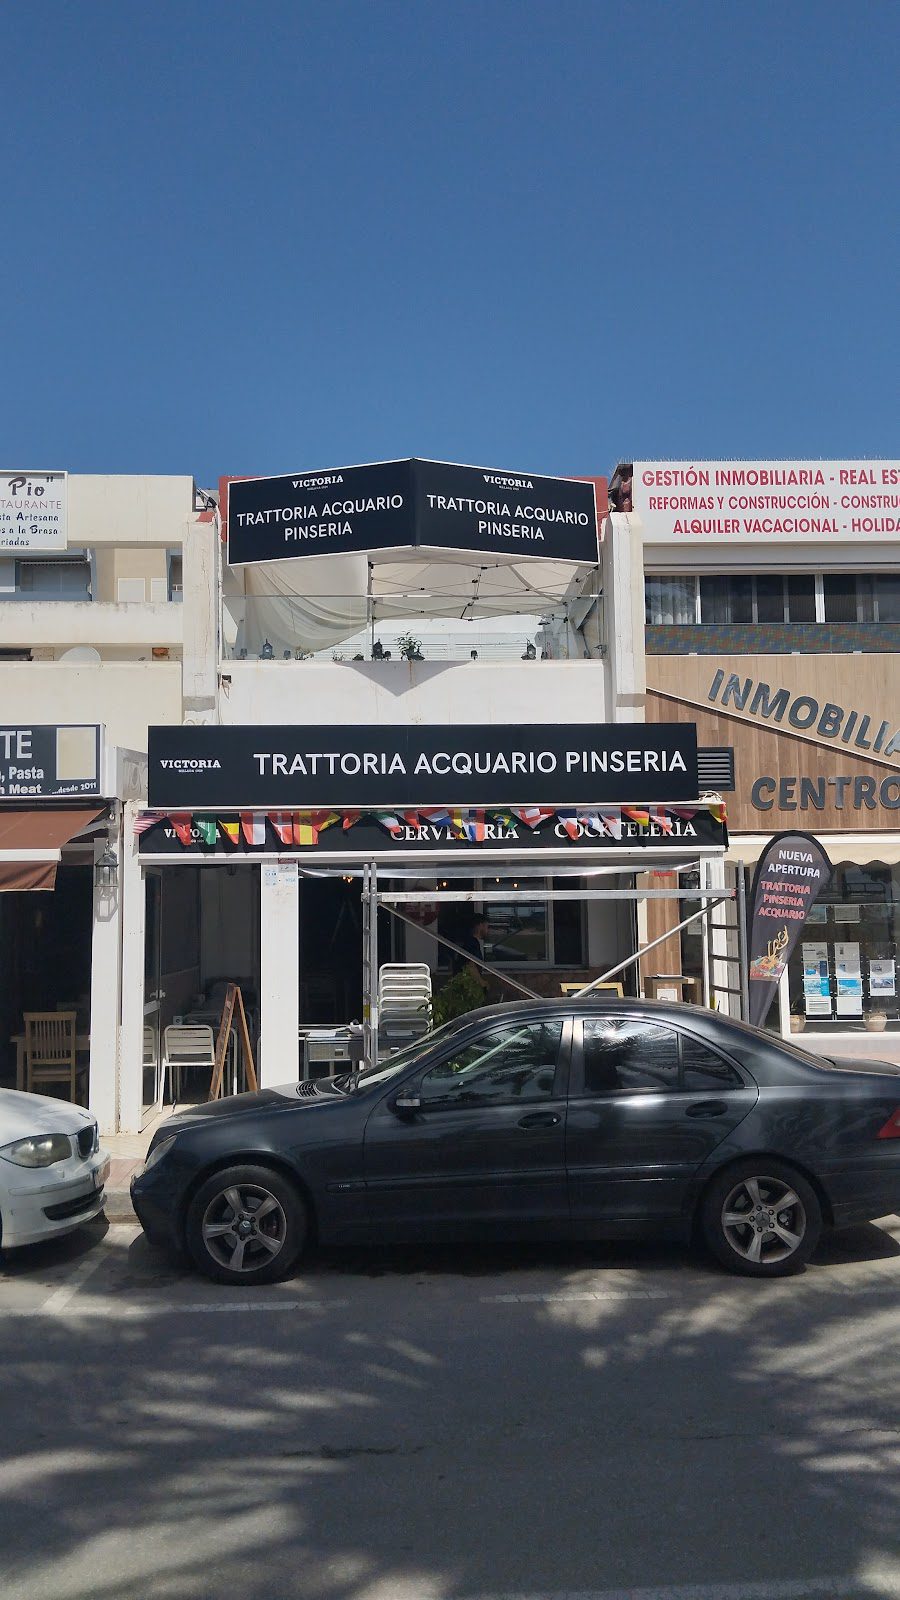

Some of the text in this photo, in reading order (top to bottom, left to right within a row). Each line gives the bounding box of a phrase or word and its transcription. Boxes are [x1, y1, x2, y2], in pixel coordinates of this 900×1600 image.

[292, 475, 344, 488] VICTORIA
[483, 475, 534, 489] VICTORIA
[642, 466, 709, 486] GESTIÓN
[715, 469, 825, 486] INMOBILIARIA
[840, 469, 877, 485] REAL
[882, 469, 900, 485] ES
[649, 496, 714, 510] REFORMAS
[717, 496, 724, 510] Y
[728, 491, 829, 510] CONSTRUCCIÓN
[841, 495, 900, 509] CONSTRU
[16, 511, 59, 522] Artesana
[237, 494, 403, 527] TRATTORIA ACQUARIO
[427, 495, 589, 526] TRATTORIA ACQUARIO
[30, 524, 58, 535] Brasa
[284, 521, 353, 542] PINSERIA
[479, 520, 545, 541] PINSERIA
[673, 518, 740, 534] ALQUILER
[743, 518, 839, 533] VACACIONAL
[160, 759, 221, 769] VICTORIA
[253, 750, 687, 776] TRATTORIA ACQUARIO PINSERIA
[8, 766, 44, 780] Pasta
[9, 783, 42, 794] Meat
[80, 781, 97, 791] 2011
[751, 776, 900, 812] CENTRO
[778, 849, 813, 863] NUEVA
[768, 863, 820, 878] APERTURA
[760, 880, 811, 895] TRATTORIA
[763, 894, 804, 907] PINSERIA
[758, 906, 805, 920] ACQUARIO
